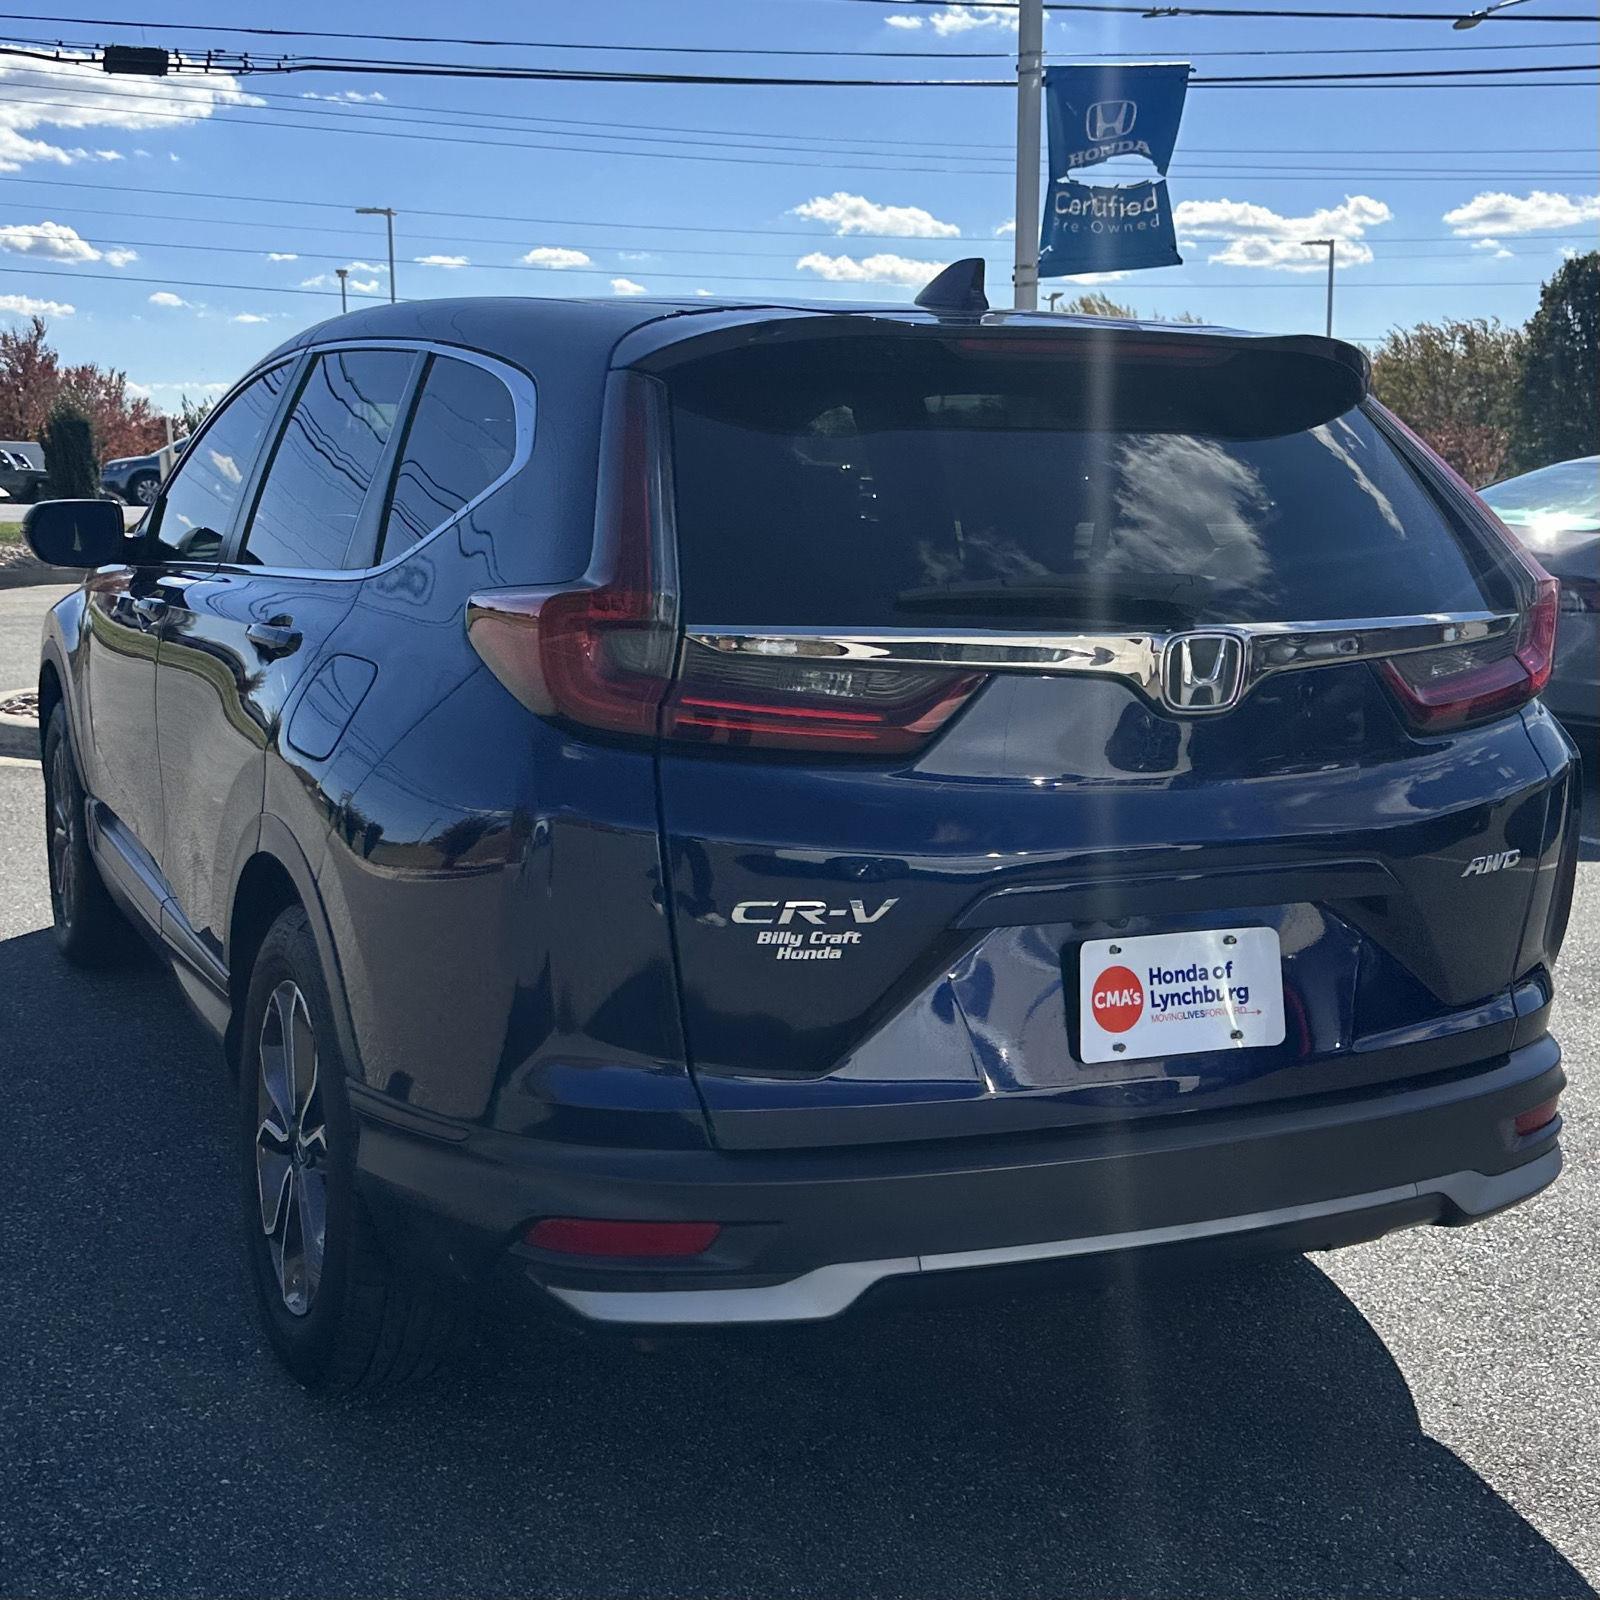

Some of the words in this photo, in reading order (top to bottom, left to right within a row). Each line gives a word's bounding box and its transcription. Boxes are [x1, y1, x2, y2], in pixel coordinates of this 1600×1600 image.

[1069, 140, 1153, 167] HONDA
[1055, 186, 1158, 220] Certified
[1460, 848, 1521, 878] AWD
[731, 897, 900, 925] CR-V
[757, 931, 803, 948] Billy
[809, 930, 863, 945] Craft
[776, 946, 843, 960] Honda
[1148, 962, 1209, 986] Honda
[1212, 960, 1233, 979] of
[1094, 988, 1143, 1009] CMA's
[1150, 985, 1249, 1012] Lynchburg
